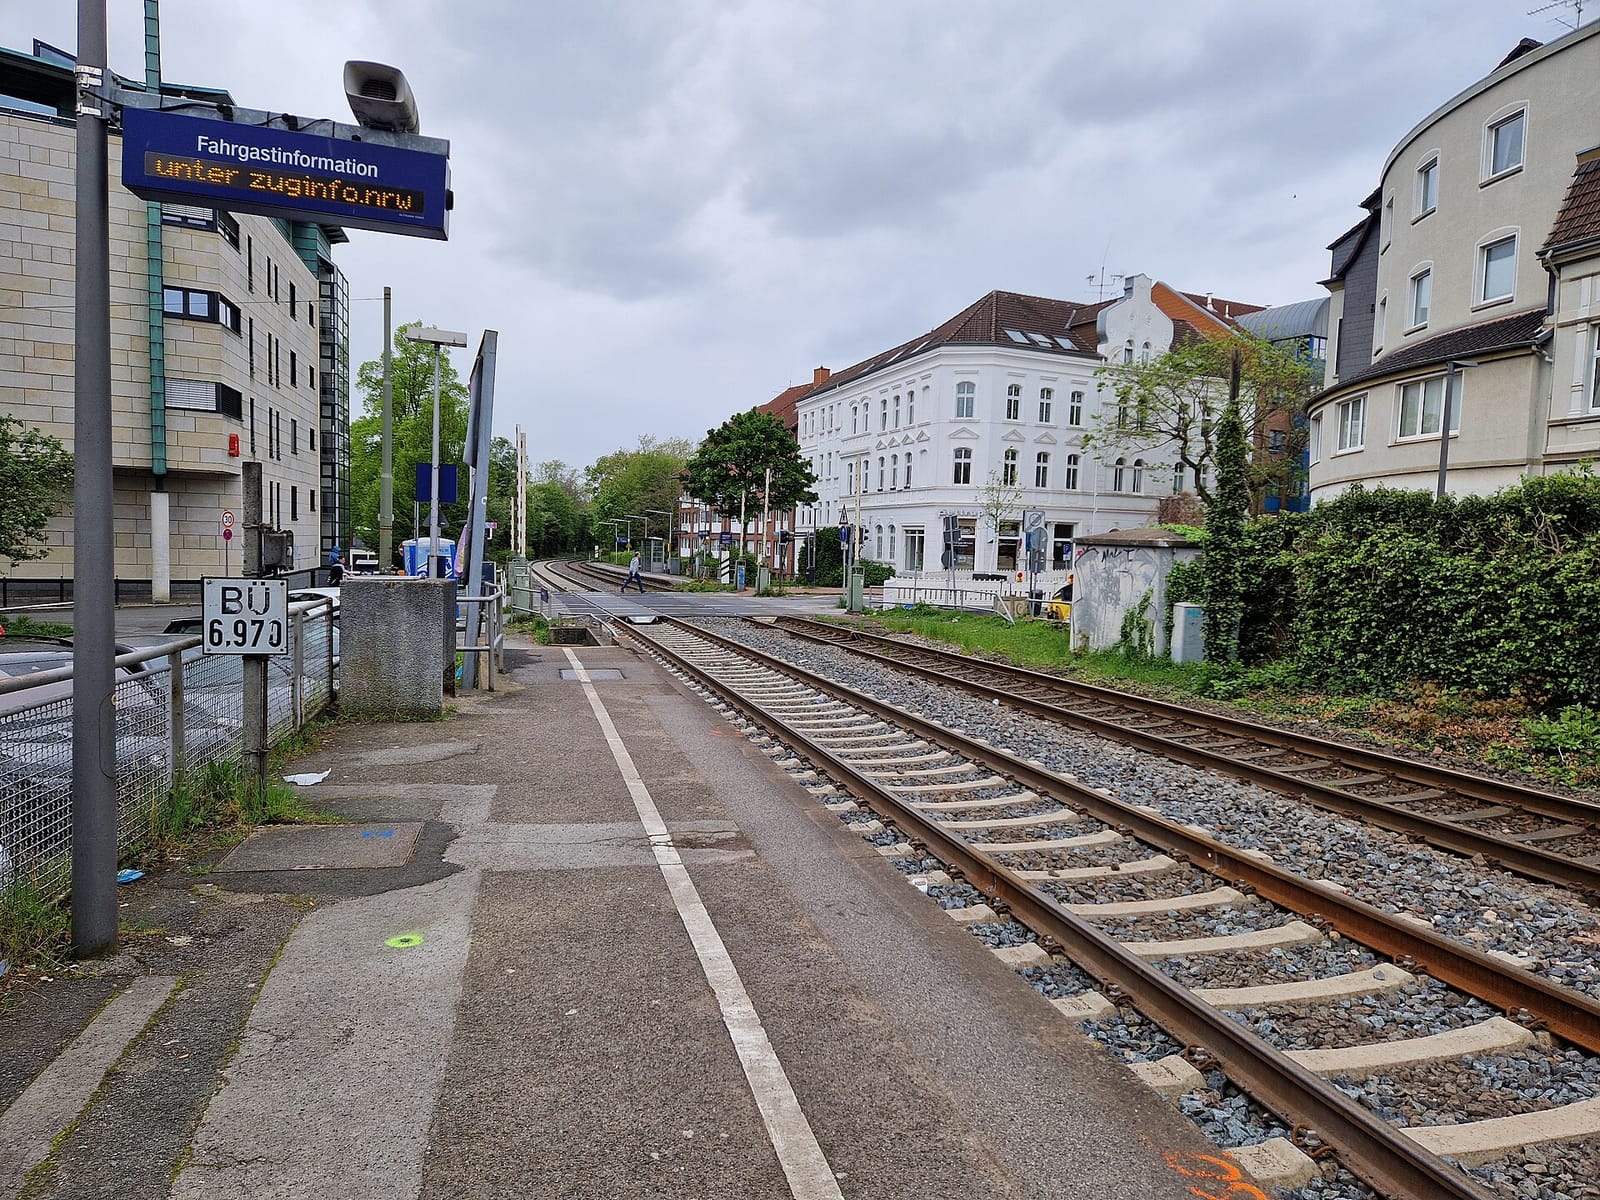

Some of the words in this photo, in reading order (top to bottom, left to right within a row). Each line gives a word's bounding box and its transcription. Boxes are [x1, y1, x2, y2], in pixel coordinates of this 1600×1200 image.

[197, 135, 379, 178] Fahrgastinformation
[154, 158, 239, 185] unter
[249, 171, 413, 210] zuginfo.nrw
[224, 515, 232, 524] 30
[221, 581, 270, 616] BÜ
